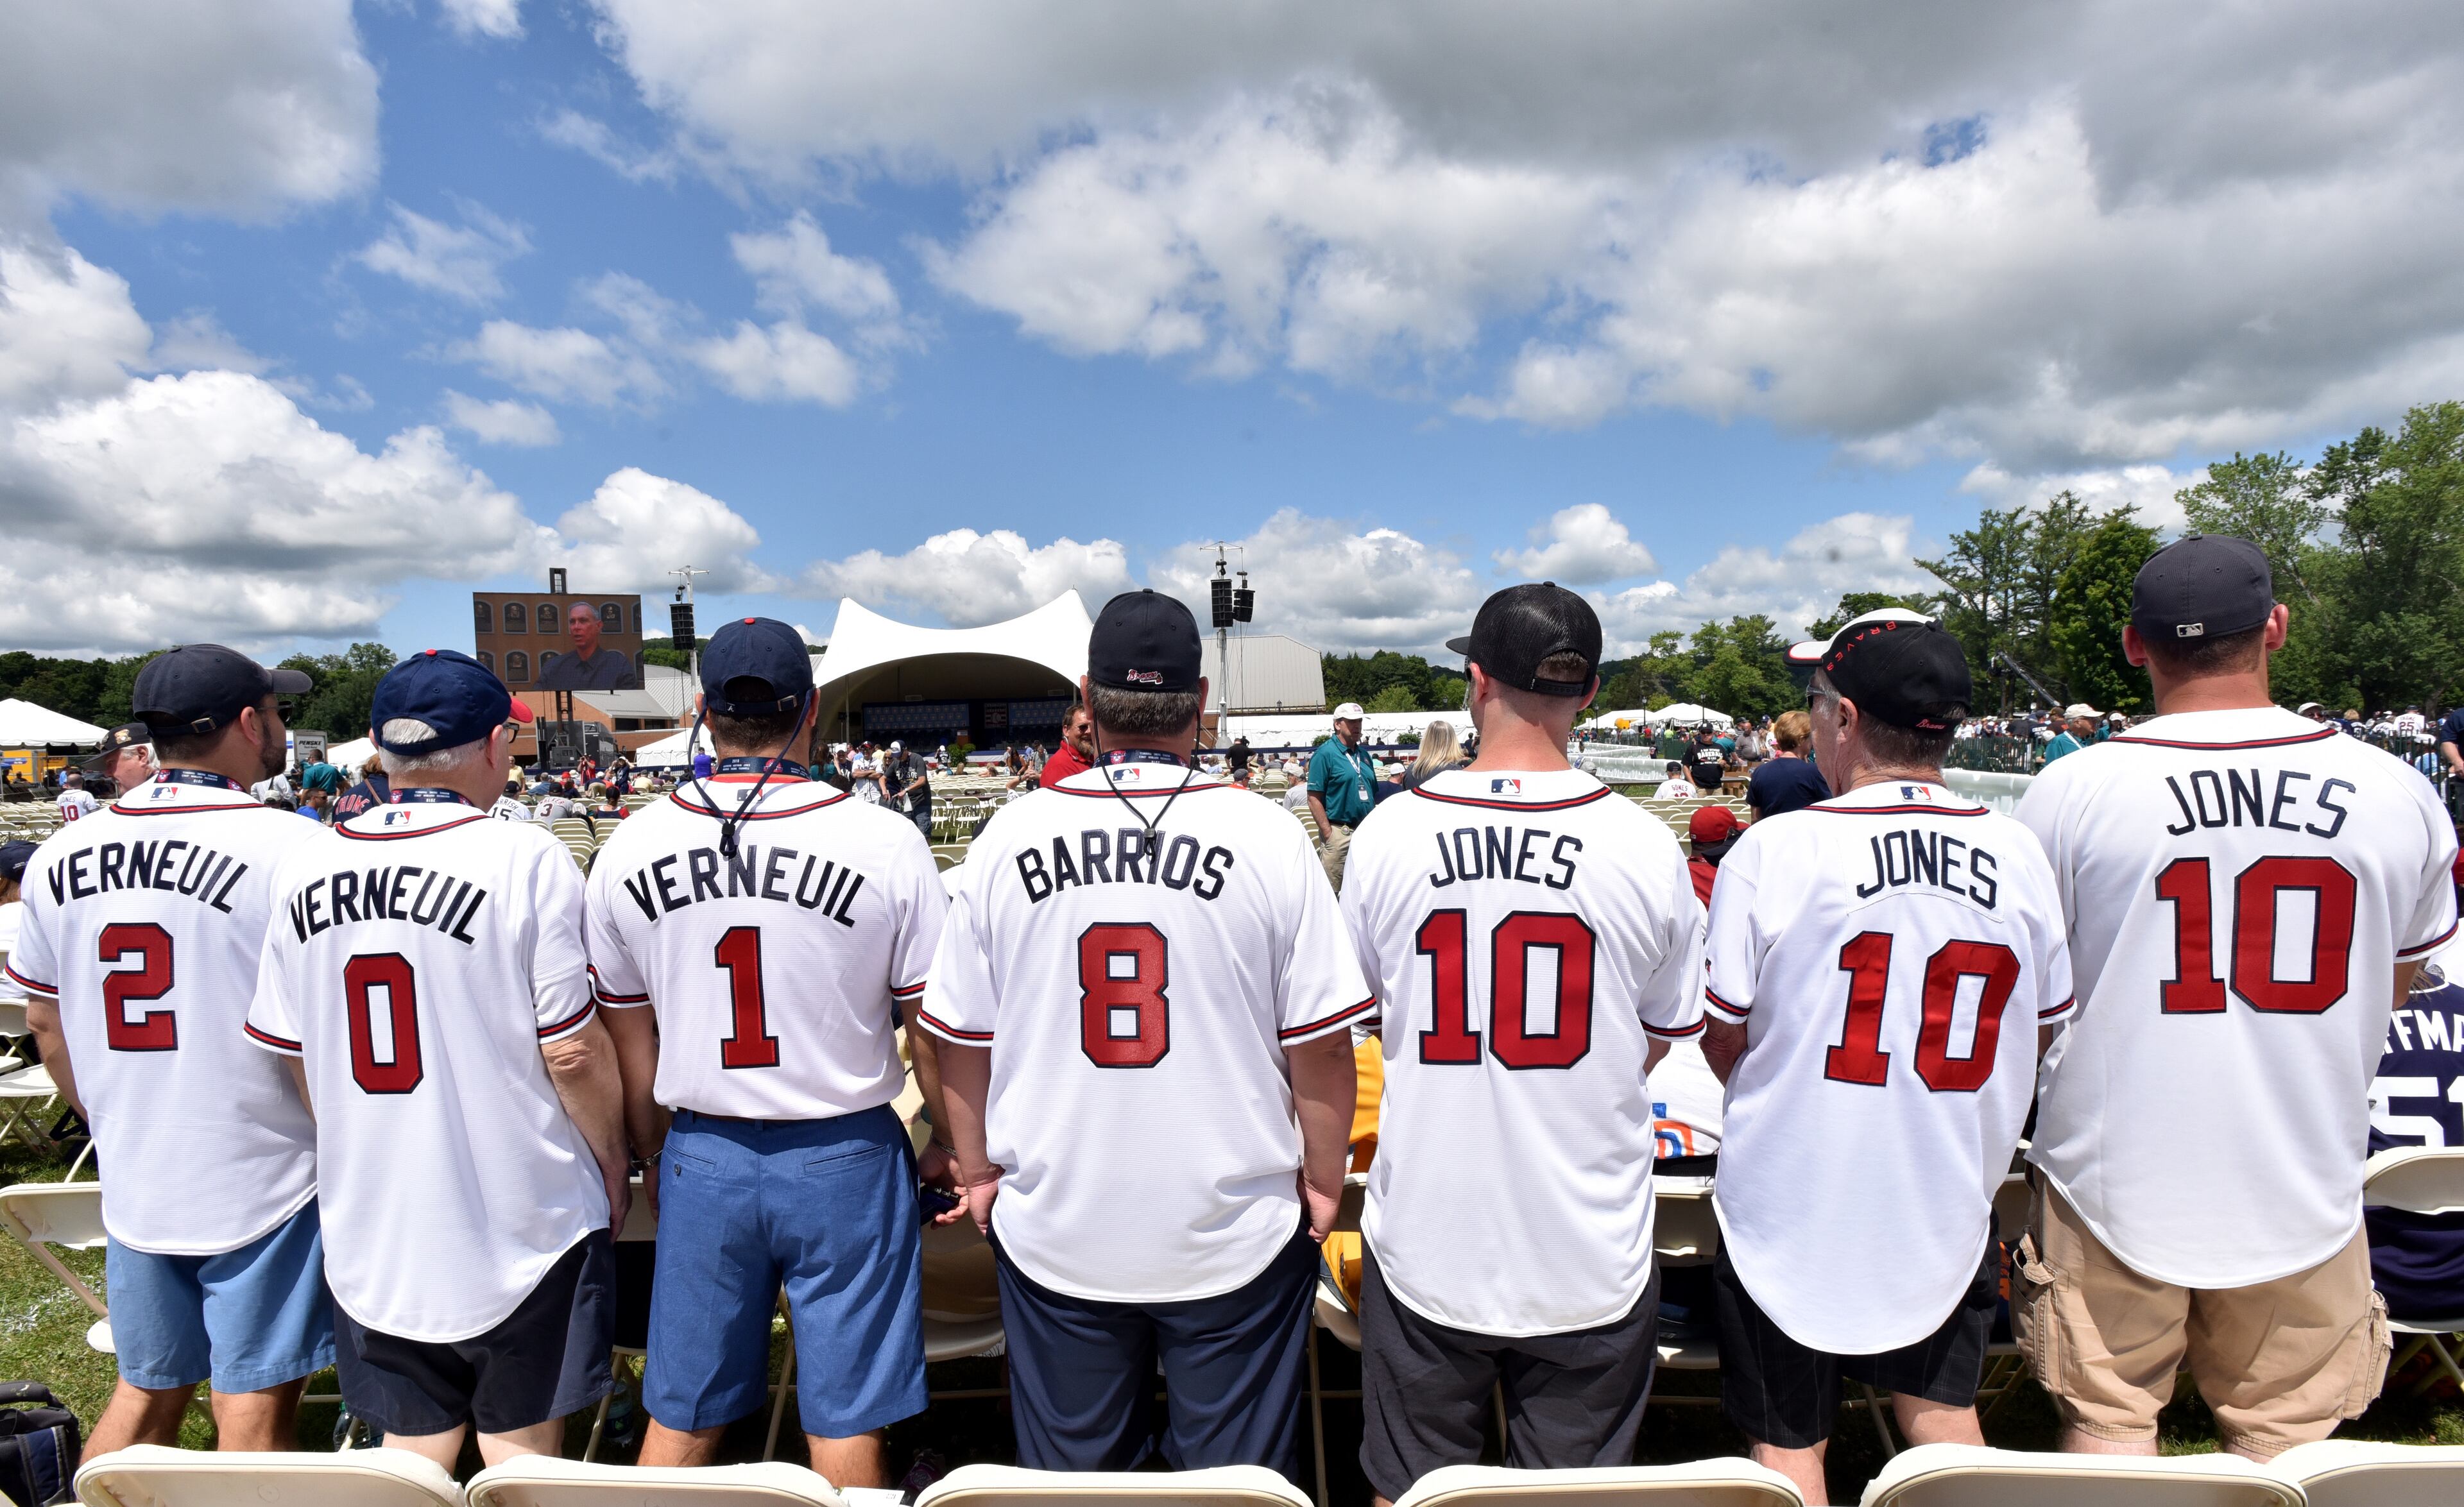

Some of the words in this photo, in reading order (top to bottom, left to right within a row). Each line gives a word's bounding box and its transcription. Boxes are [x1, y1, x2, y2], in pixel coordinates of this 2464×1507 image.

[1827, 620, 1897, 671] BRAVES
[2399, 721, 2415, 731] 25
[61, 805, 80, 822] 10
[492, 806, 512, 821] 15
[495, 799, 519, 810] ARRISH
[540, 803, 553, 817] 3
[2166, 769, 2355, 839] JONES
[48, 840, 248, 914] VERNEUIL
[623, 844, 865, 929] VERNEUIL
[1015, 828, 1235, 905] BARRIOS
[1429, 826, 1583, 890] JONES
[1856, 829, 1998, 910] JONES
[290, 865, 487, 946] VERNEUIL
[2155, 855, 2357, 1015] 10
[98, 922, 178, 1052] 2
[343, 951, 424, 1095] 0
[714, 926, 780, 1069] 1
[1077, 922, 1170, 1069] 8
[1415, 908, 1597, 1071] 10
[1824, 930, 2021, 1093] 10
